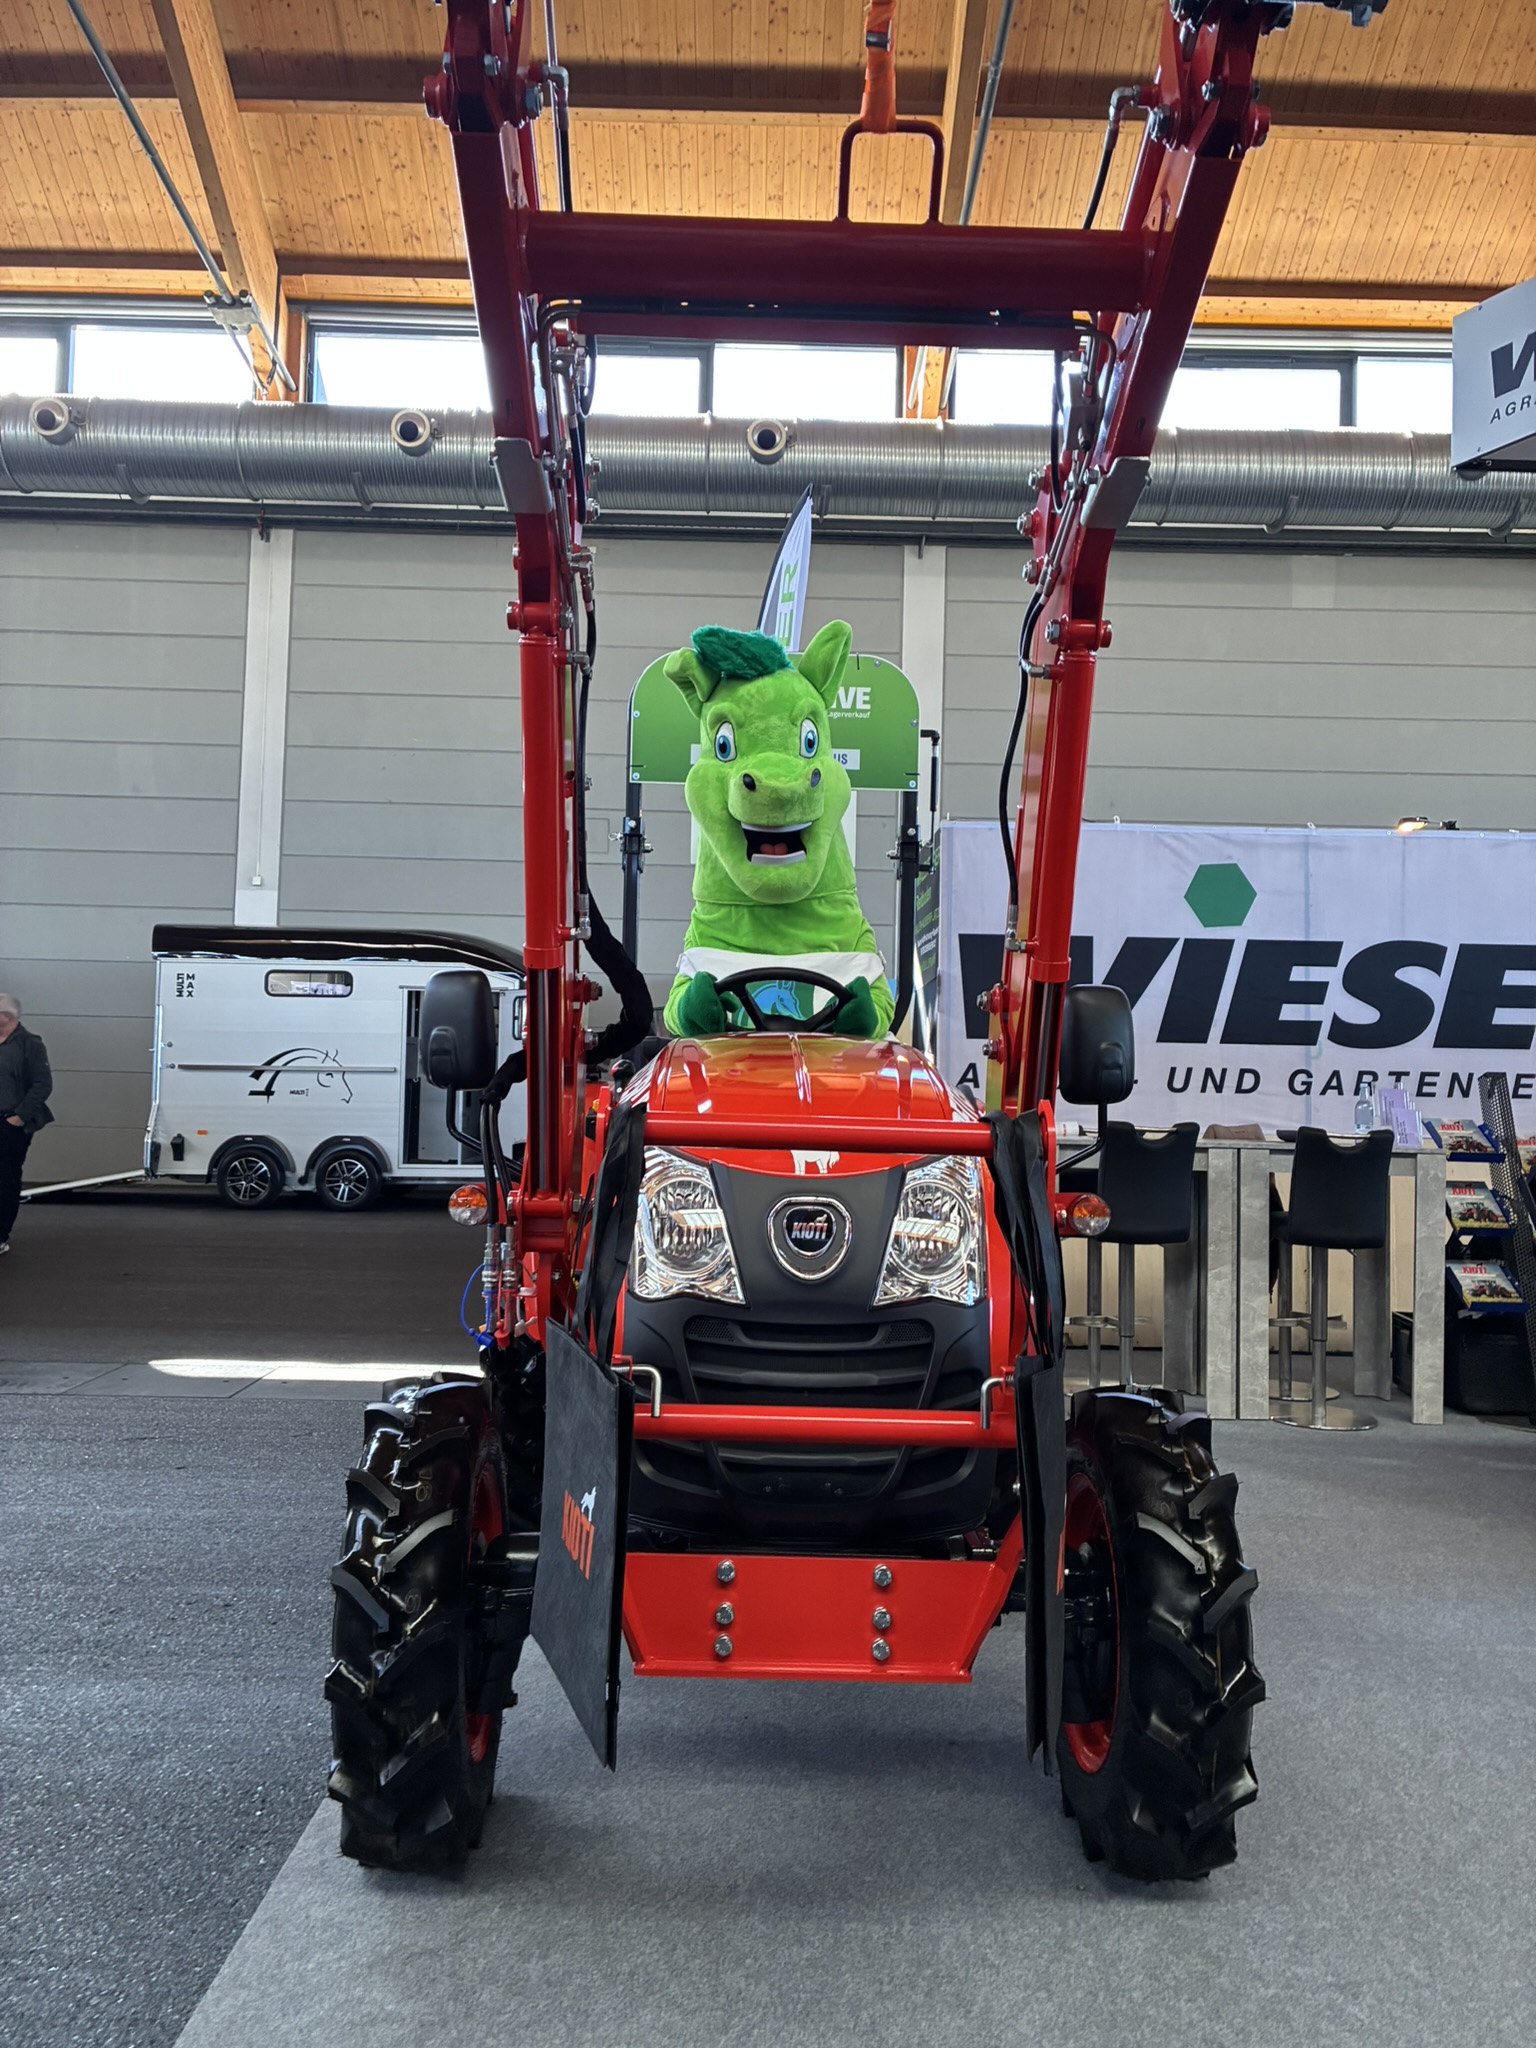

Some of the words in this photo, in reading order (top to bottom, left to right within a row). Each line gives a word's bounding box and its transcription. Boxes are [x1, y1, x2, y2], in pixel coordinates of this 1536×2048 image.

[1490, 395, 1536, 424] AGR
[827, 710, 871, 720] agerverkauf
[176, 973, 185, 998] MULTI
[186, 973, 195, 998] MAX
[1167, 1067, 1261, 1095] UND
[791, 1222, 829, 1240] KIOTI
[561, 1489, 595, 1581] KIOTI
